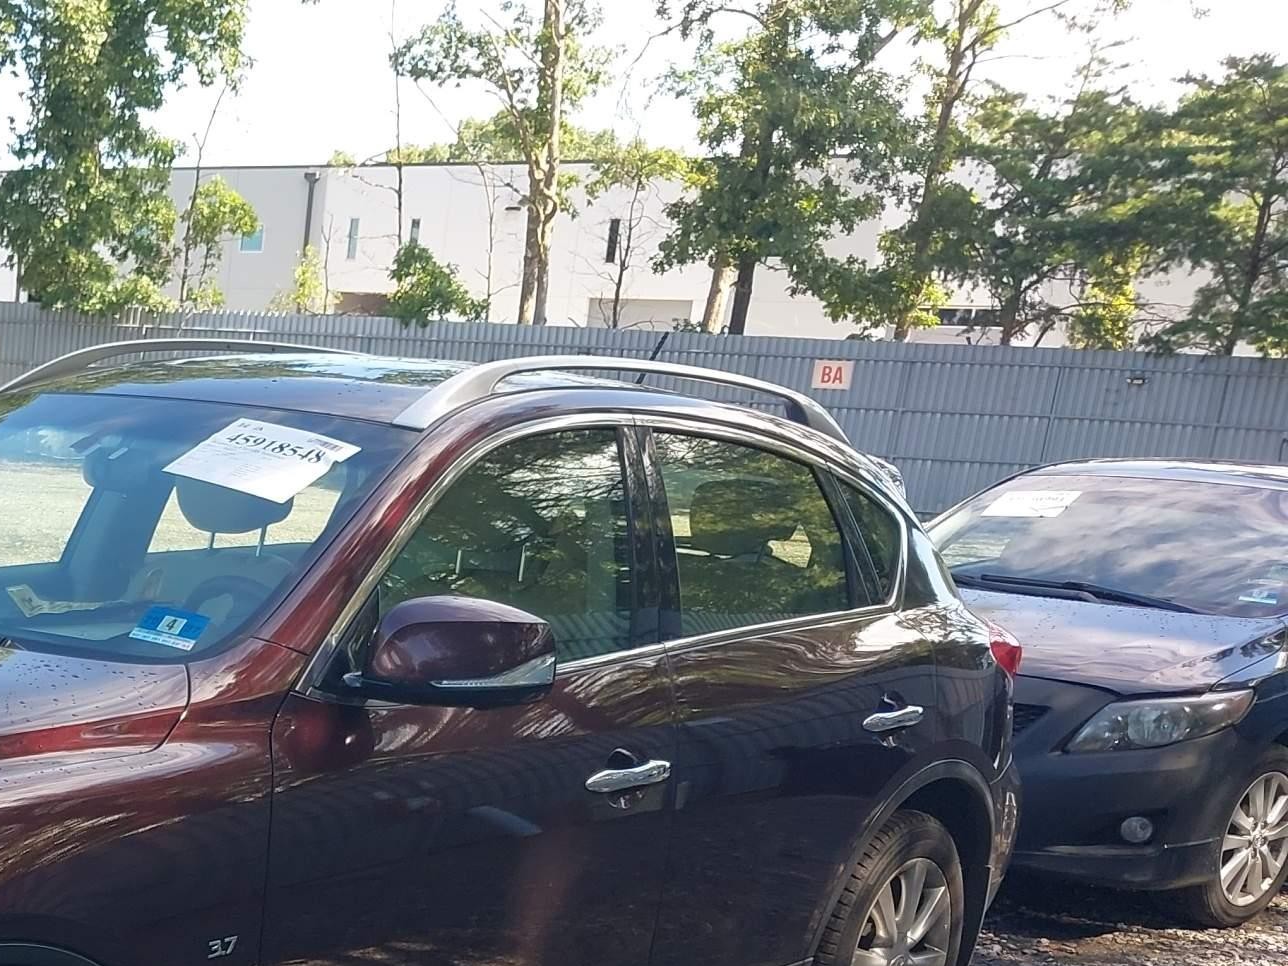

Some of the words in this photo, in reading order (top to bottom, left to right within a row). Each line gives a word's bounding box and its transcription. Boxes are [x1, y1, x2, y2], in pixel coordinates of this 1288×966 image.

[821, 366, 843, 384] BA
[226, 433, 326, 463] 45918548
[166, 619, 179, 631] 4
